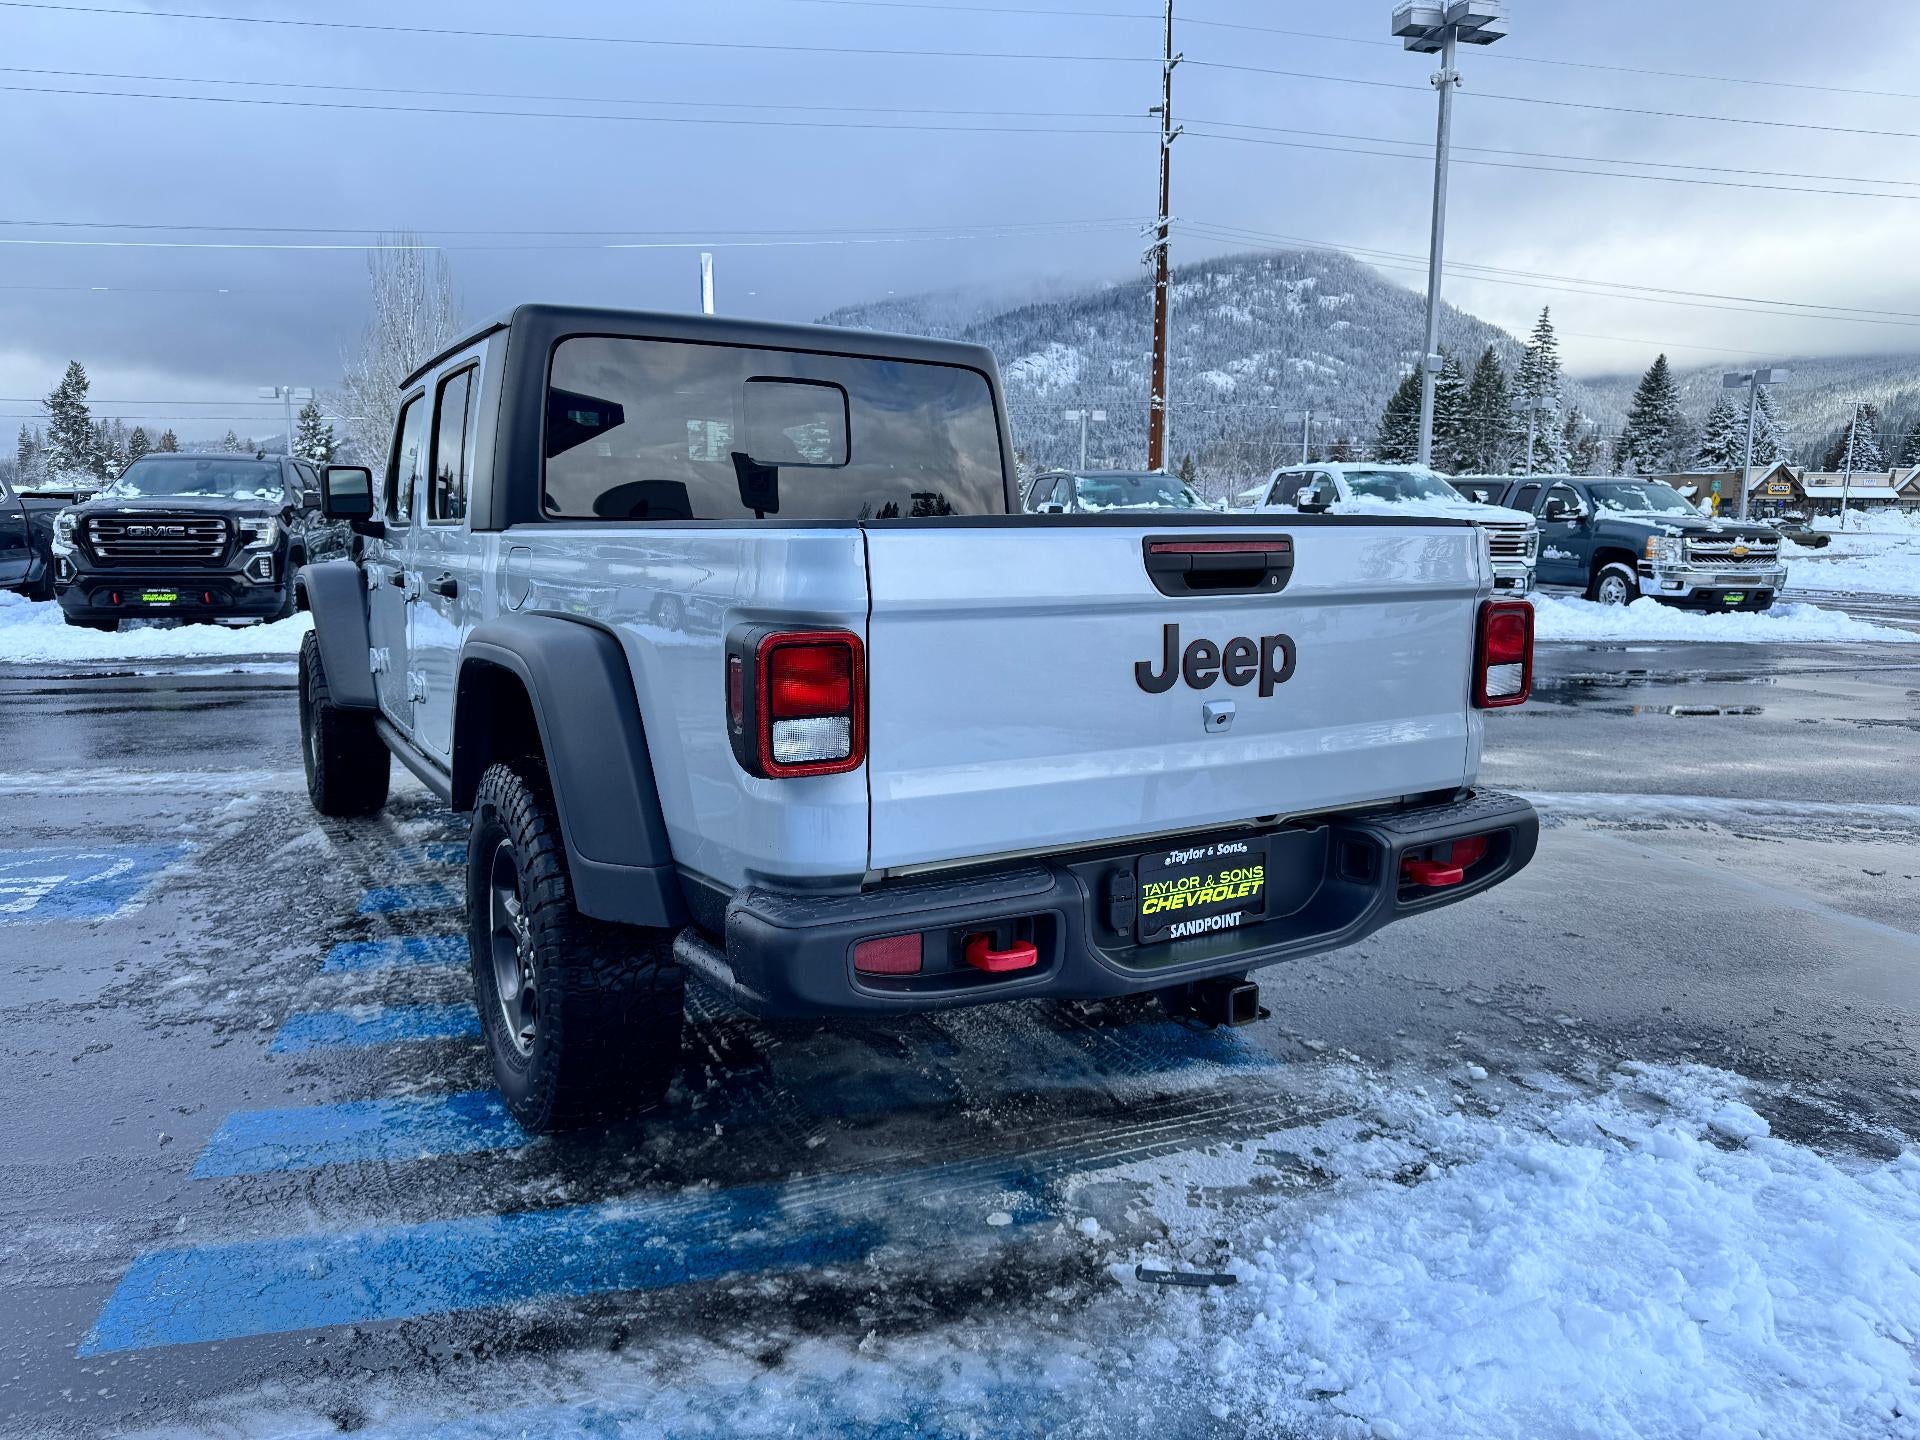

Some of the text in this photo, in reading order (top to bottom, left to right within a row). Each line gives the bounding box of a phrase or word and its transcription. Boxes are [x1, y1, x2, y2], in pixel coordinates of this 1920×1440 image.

[126, 525, 185, 537] GMC
[1134, 623, 1297, 698] Jeep
[1170, 842, 1242, 865] Taylor & Sons
[1142, 865, 1264, 897] TAYLOR & SONS
[1142, 880, 1263, 915] CHEVROLET
[1170, 911, 1242, 939] SANDPOINT
